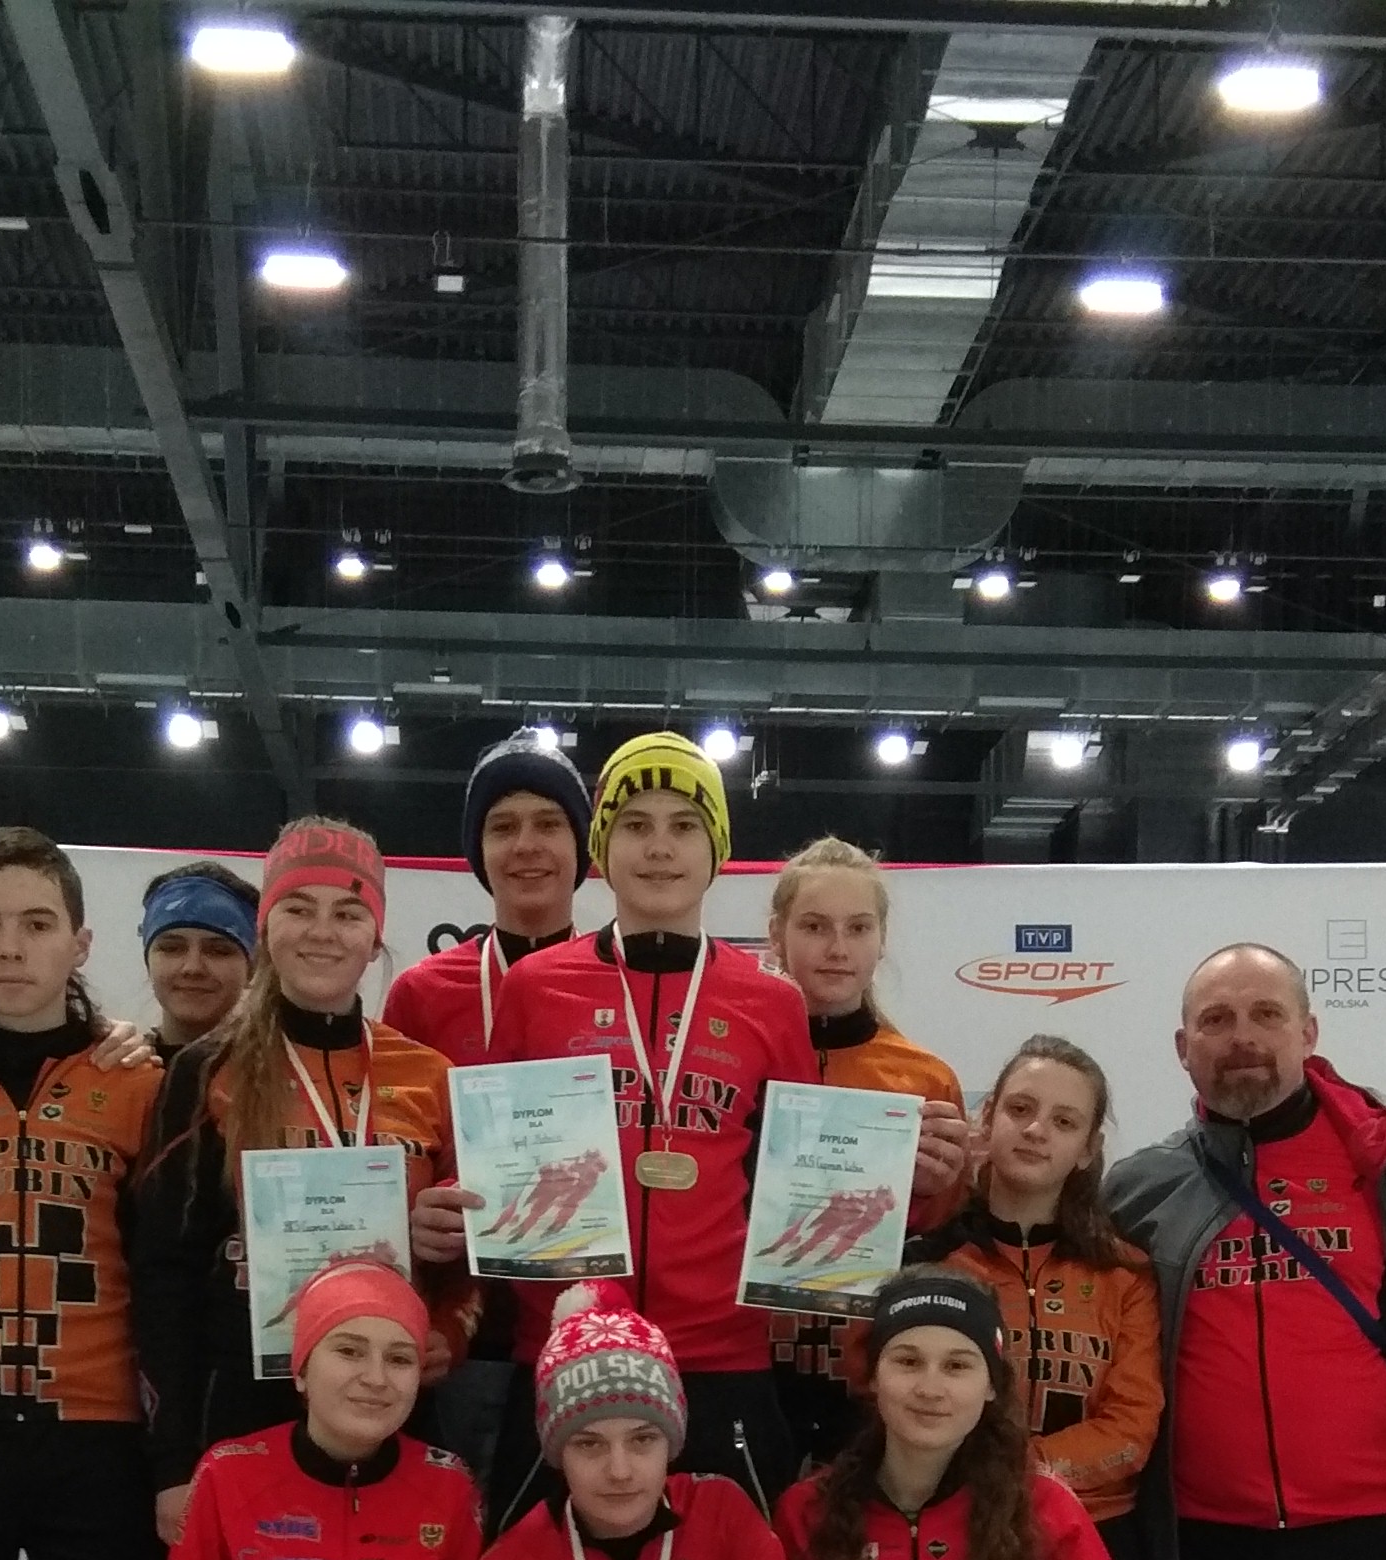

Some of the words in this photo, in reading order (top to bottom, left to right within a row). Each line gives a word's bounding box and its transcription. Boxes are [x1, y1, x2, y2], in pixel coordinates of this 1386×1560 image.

[1024, 932, 1062, 945] TVP
[977, 962, 1115, 981] SPORT
[1325, 1000, 1369, 1009] POLSKA
[612, 1067, 741, 1113] PRUM
[512, 1108, 554, 1119] DYPLOM
[615, 1100, 721, 1134] UBIN
[819, 1133, 859, 1146] DYPLOM
[1194, 1254, 1335, 1290] LUBI
[889, 1295, 931, 1315] CUPRUM
[933, 1294, 967, 1312] LUBIN
[1007, 1327, 1113, 1363] PRUM
[556, 1354, 670, 1399] POLSKA
